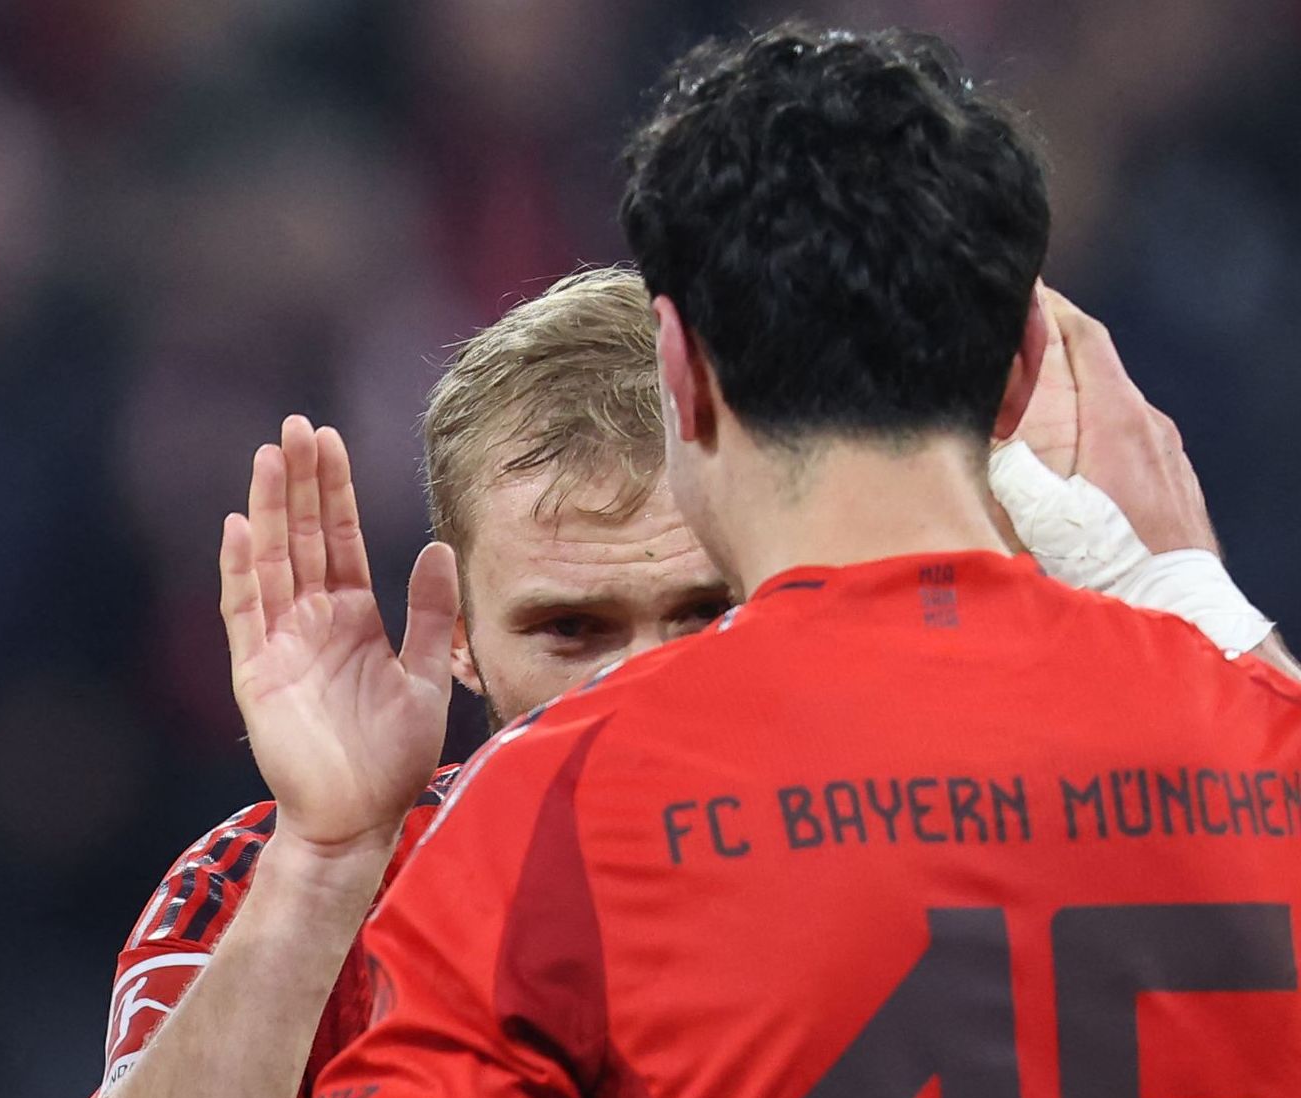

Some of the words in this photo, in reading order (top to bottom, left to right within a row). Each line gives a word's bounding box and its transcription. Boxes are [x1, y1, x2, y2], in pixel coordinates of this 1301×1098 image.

[662, 796, 751, 866] FC
[778, 776, 1033, 850] BAYERN
[1059, 766, 1301, 842] MÜNCHEN
